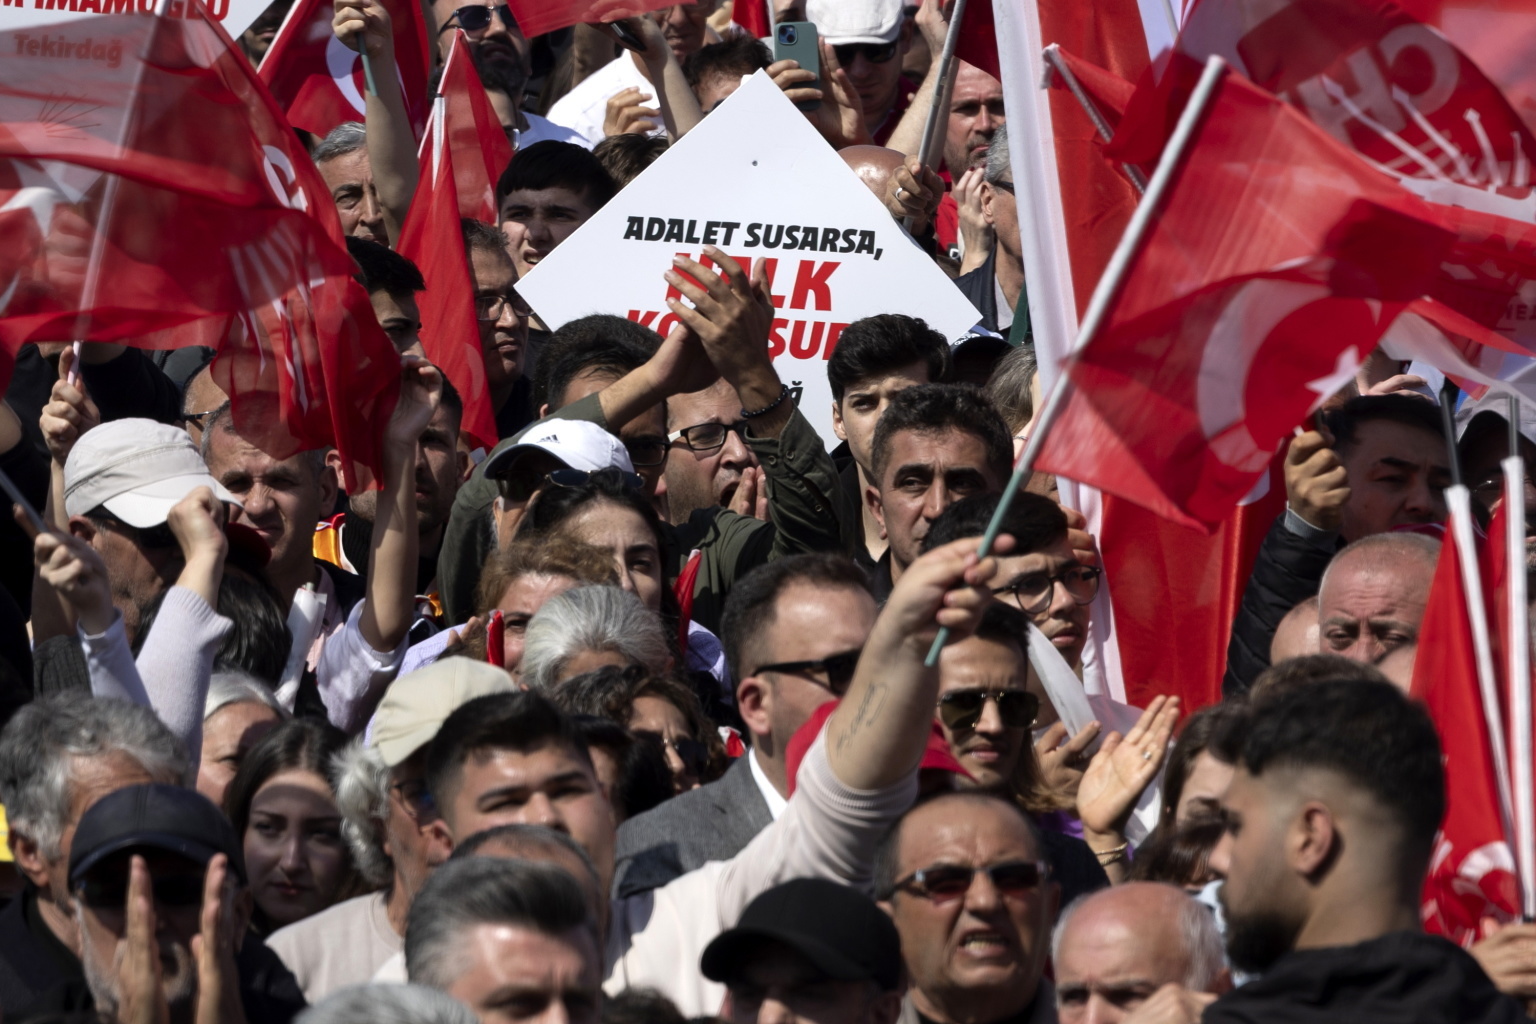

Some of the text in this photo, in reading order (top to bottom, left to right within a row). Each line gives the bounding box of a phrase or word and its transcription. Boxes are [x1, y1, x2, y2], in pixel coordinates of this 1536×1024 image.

[15, 33, 123, 69] Tekirdağ
[623, 215, 884, 261] ADALET SUSARSA,
